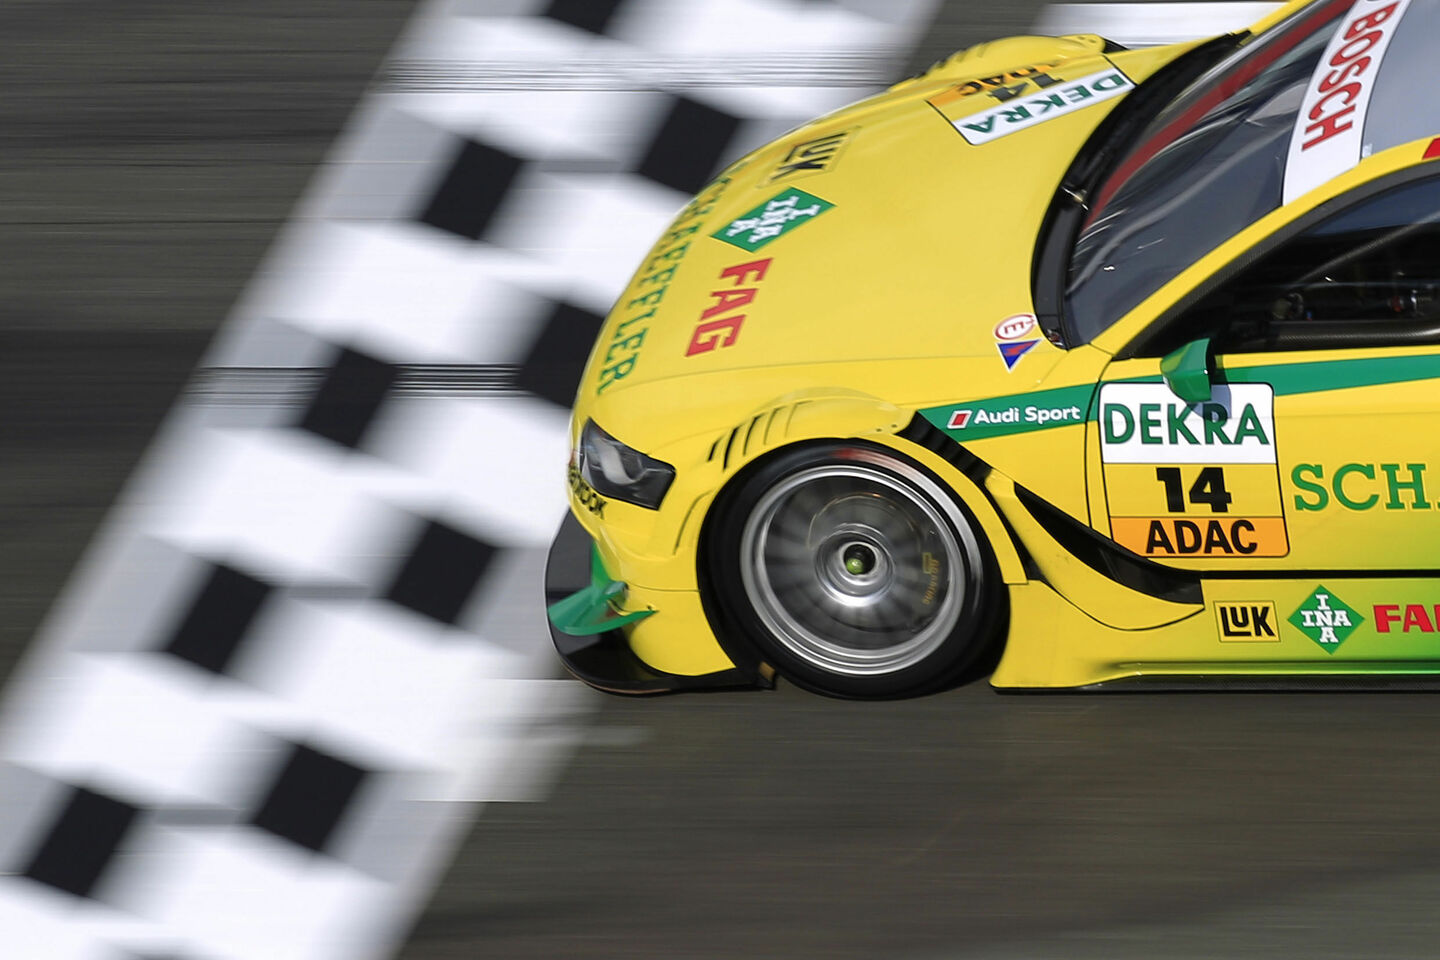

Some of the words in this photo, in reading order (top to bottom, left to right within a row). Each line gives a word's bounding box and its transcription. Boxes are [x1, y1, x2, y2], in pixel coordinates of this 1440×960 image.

[1301, 0, 1402, 152] BOSCH
[962, 73, 1128, 134] DEKRA
[684, 257, 774, 358] FAG
[974, 407, 1020, 424] Audi
[1024, 406, 1081, 425] Sport
[1103, 403, 1270, 445] DEKRA
[1155, 467, 1232, 512] 14
[1145, 520, 1258, 554] ADAC
